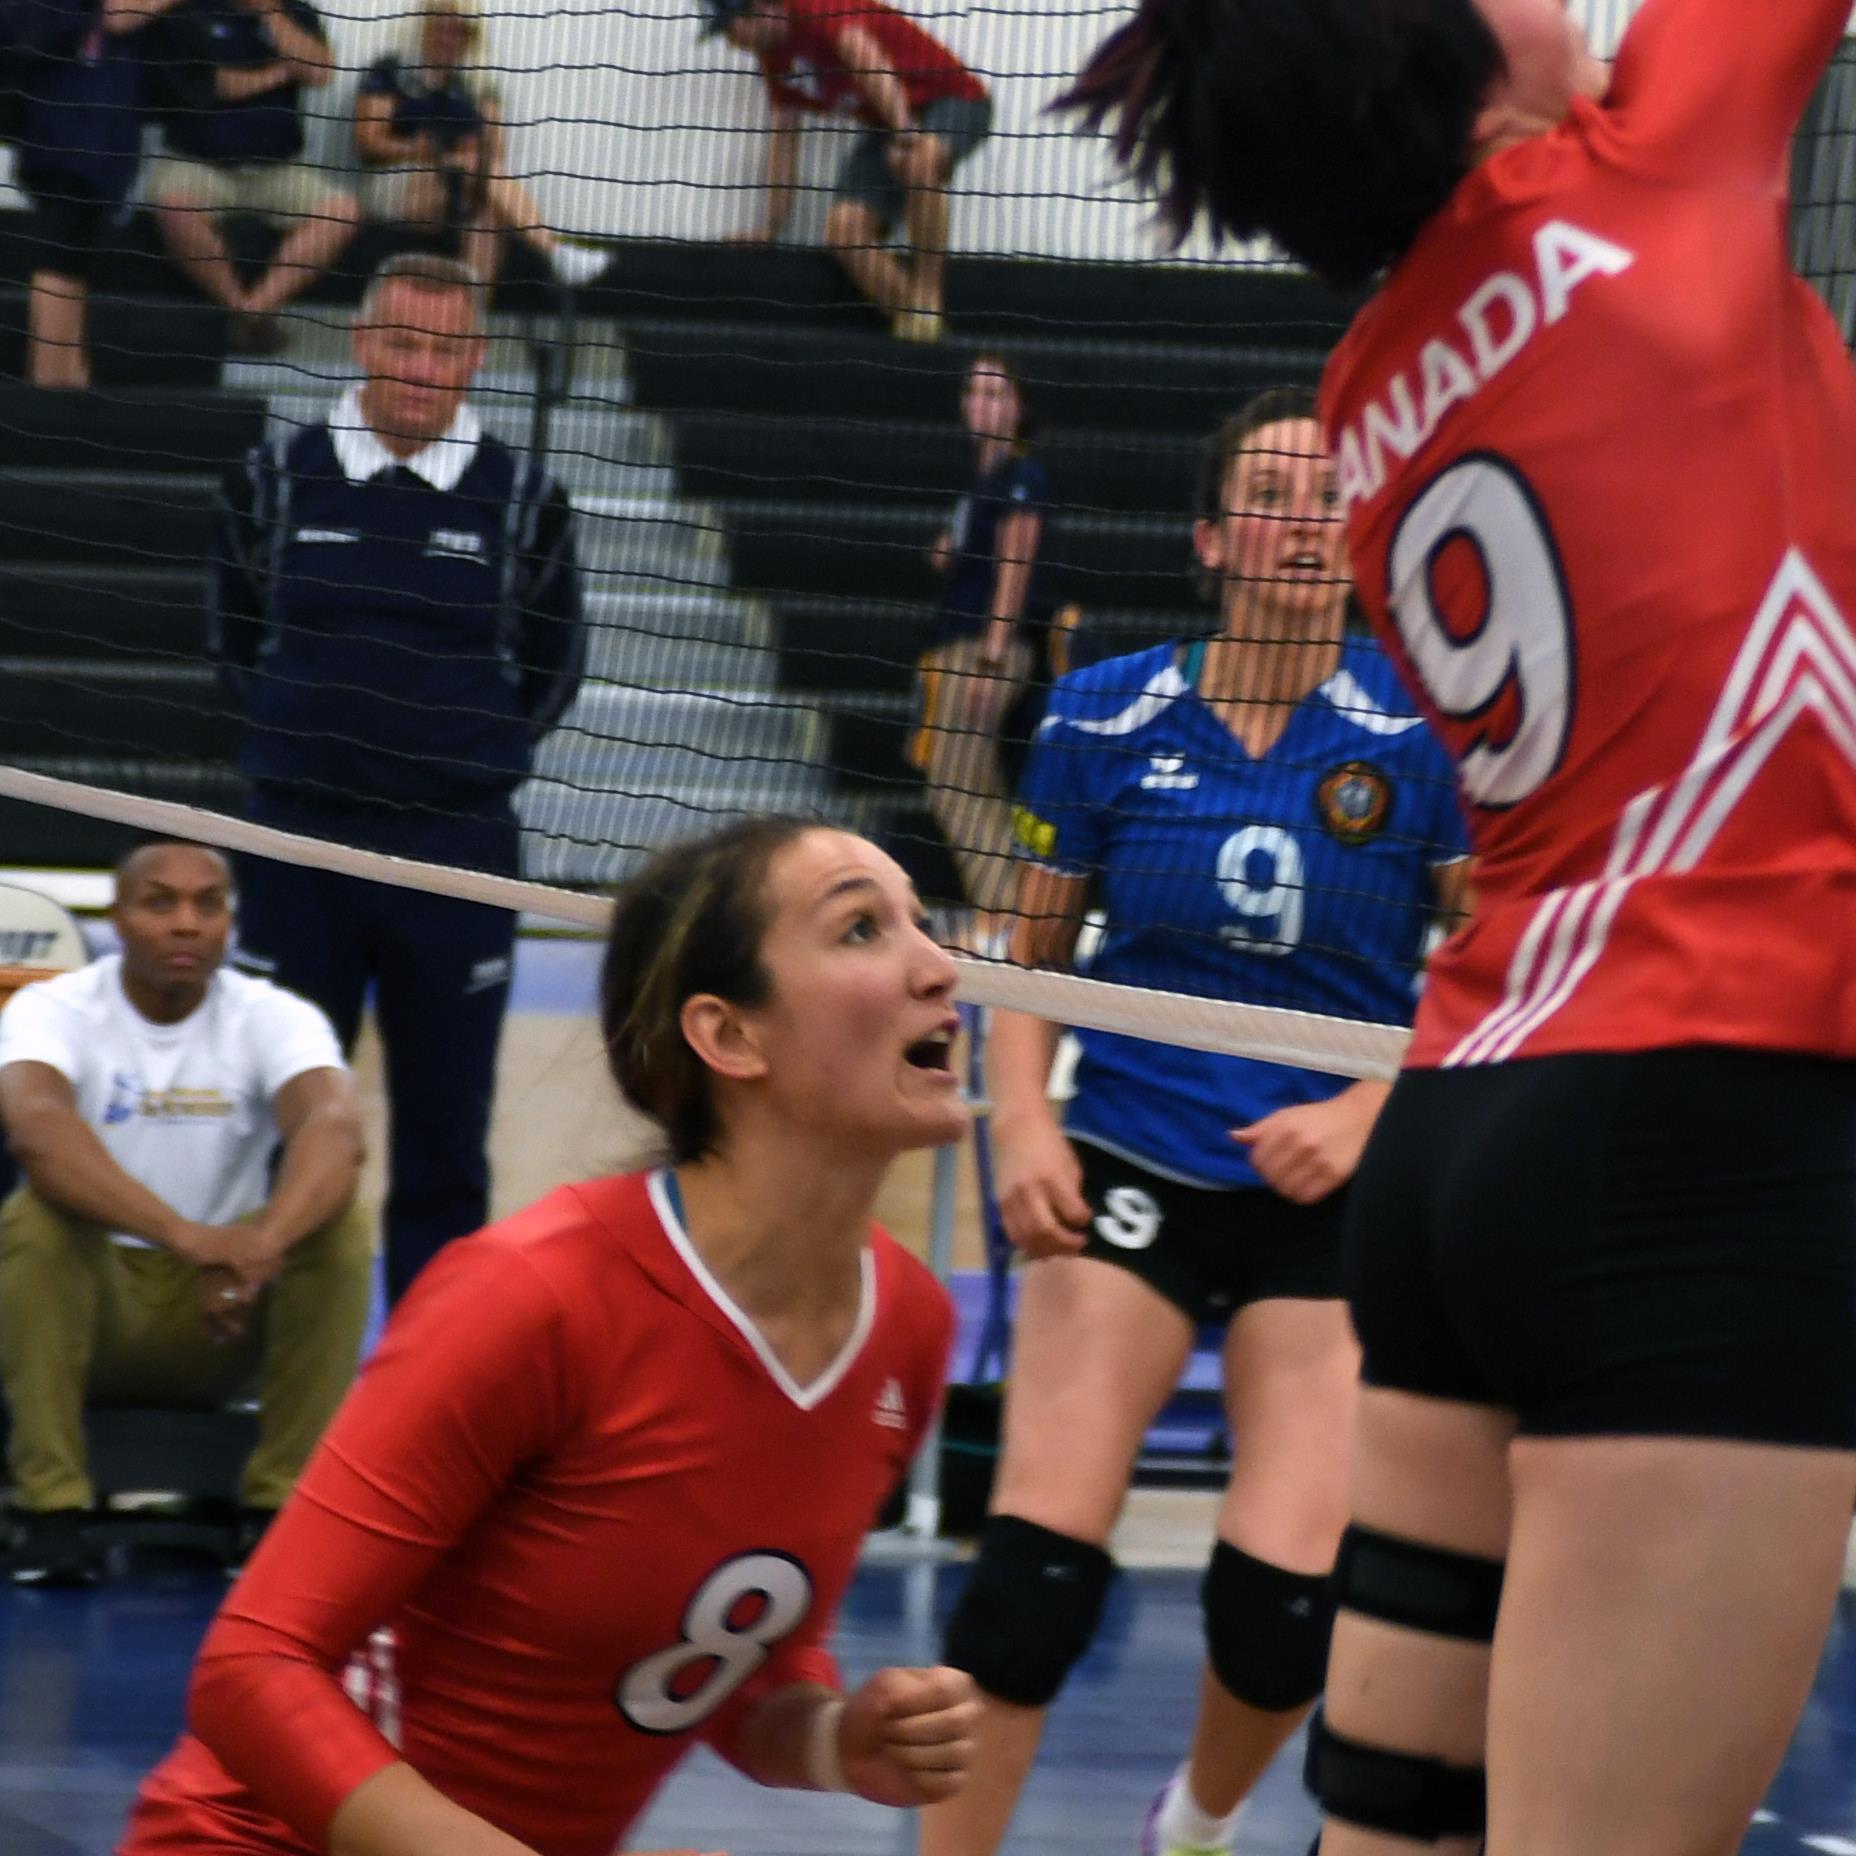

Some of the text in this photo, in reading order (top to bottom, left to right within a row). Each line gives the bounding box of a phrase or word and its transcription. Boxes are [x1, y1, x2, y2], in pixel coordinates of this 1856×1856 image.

[1389, 452, 1576, 808] 9
[1215, 824, 1306, 957] 9
[616, 1548, 813, 1736] 8
